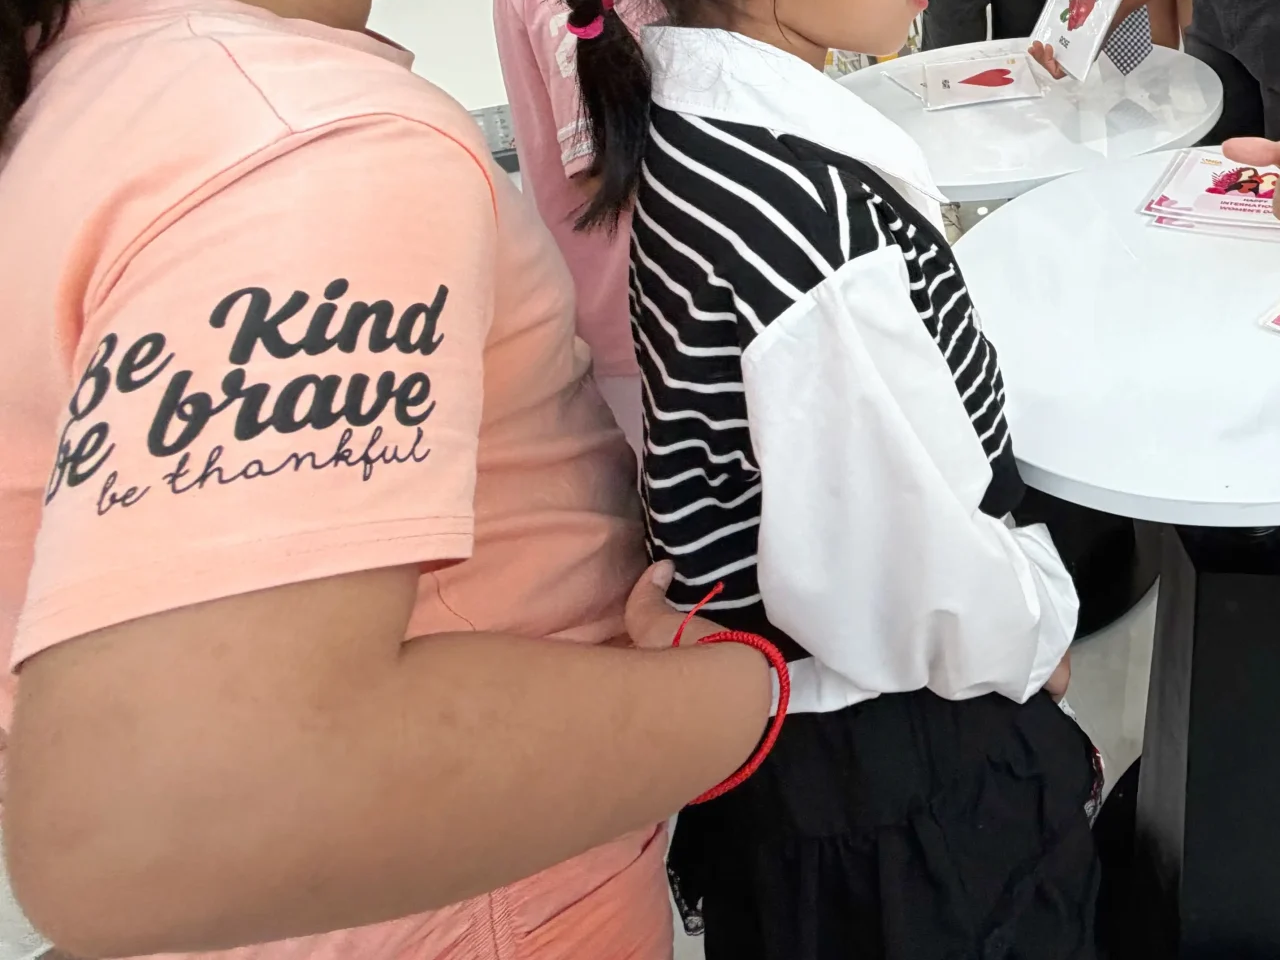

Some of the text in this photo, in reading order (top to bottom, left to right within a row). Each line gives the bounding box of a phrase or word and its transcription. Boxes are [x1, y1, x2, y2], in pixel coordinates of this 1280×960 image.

[69, 278, 449, 421] Be Kind
[148, 367, 436, 457] brave
[97, 426, 431, 516] be thankful
